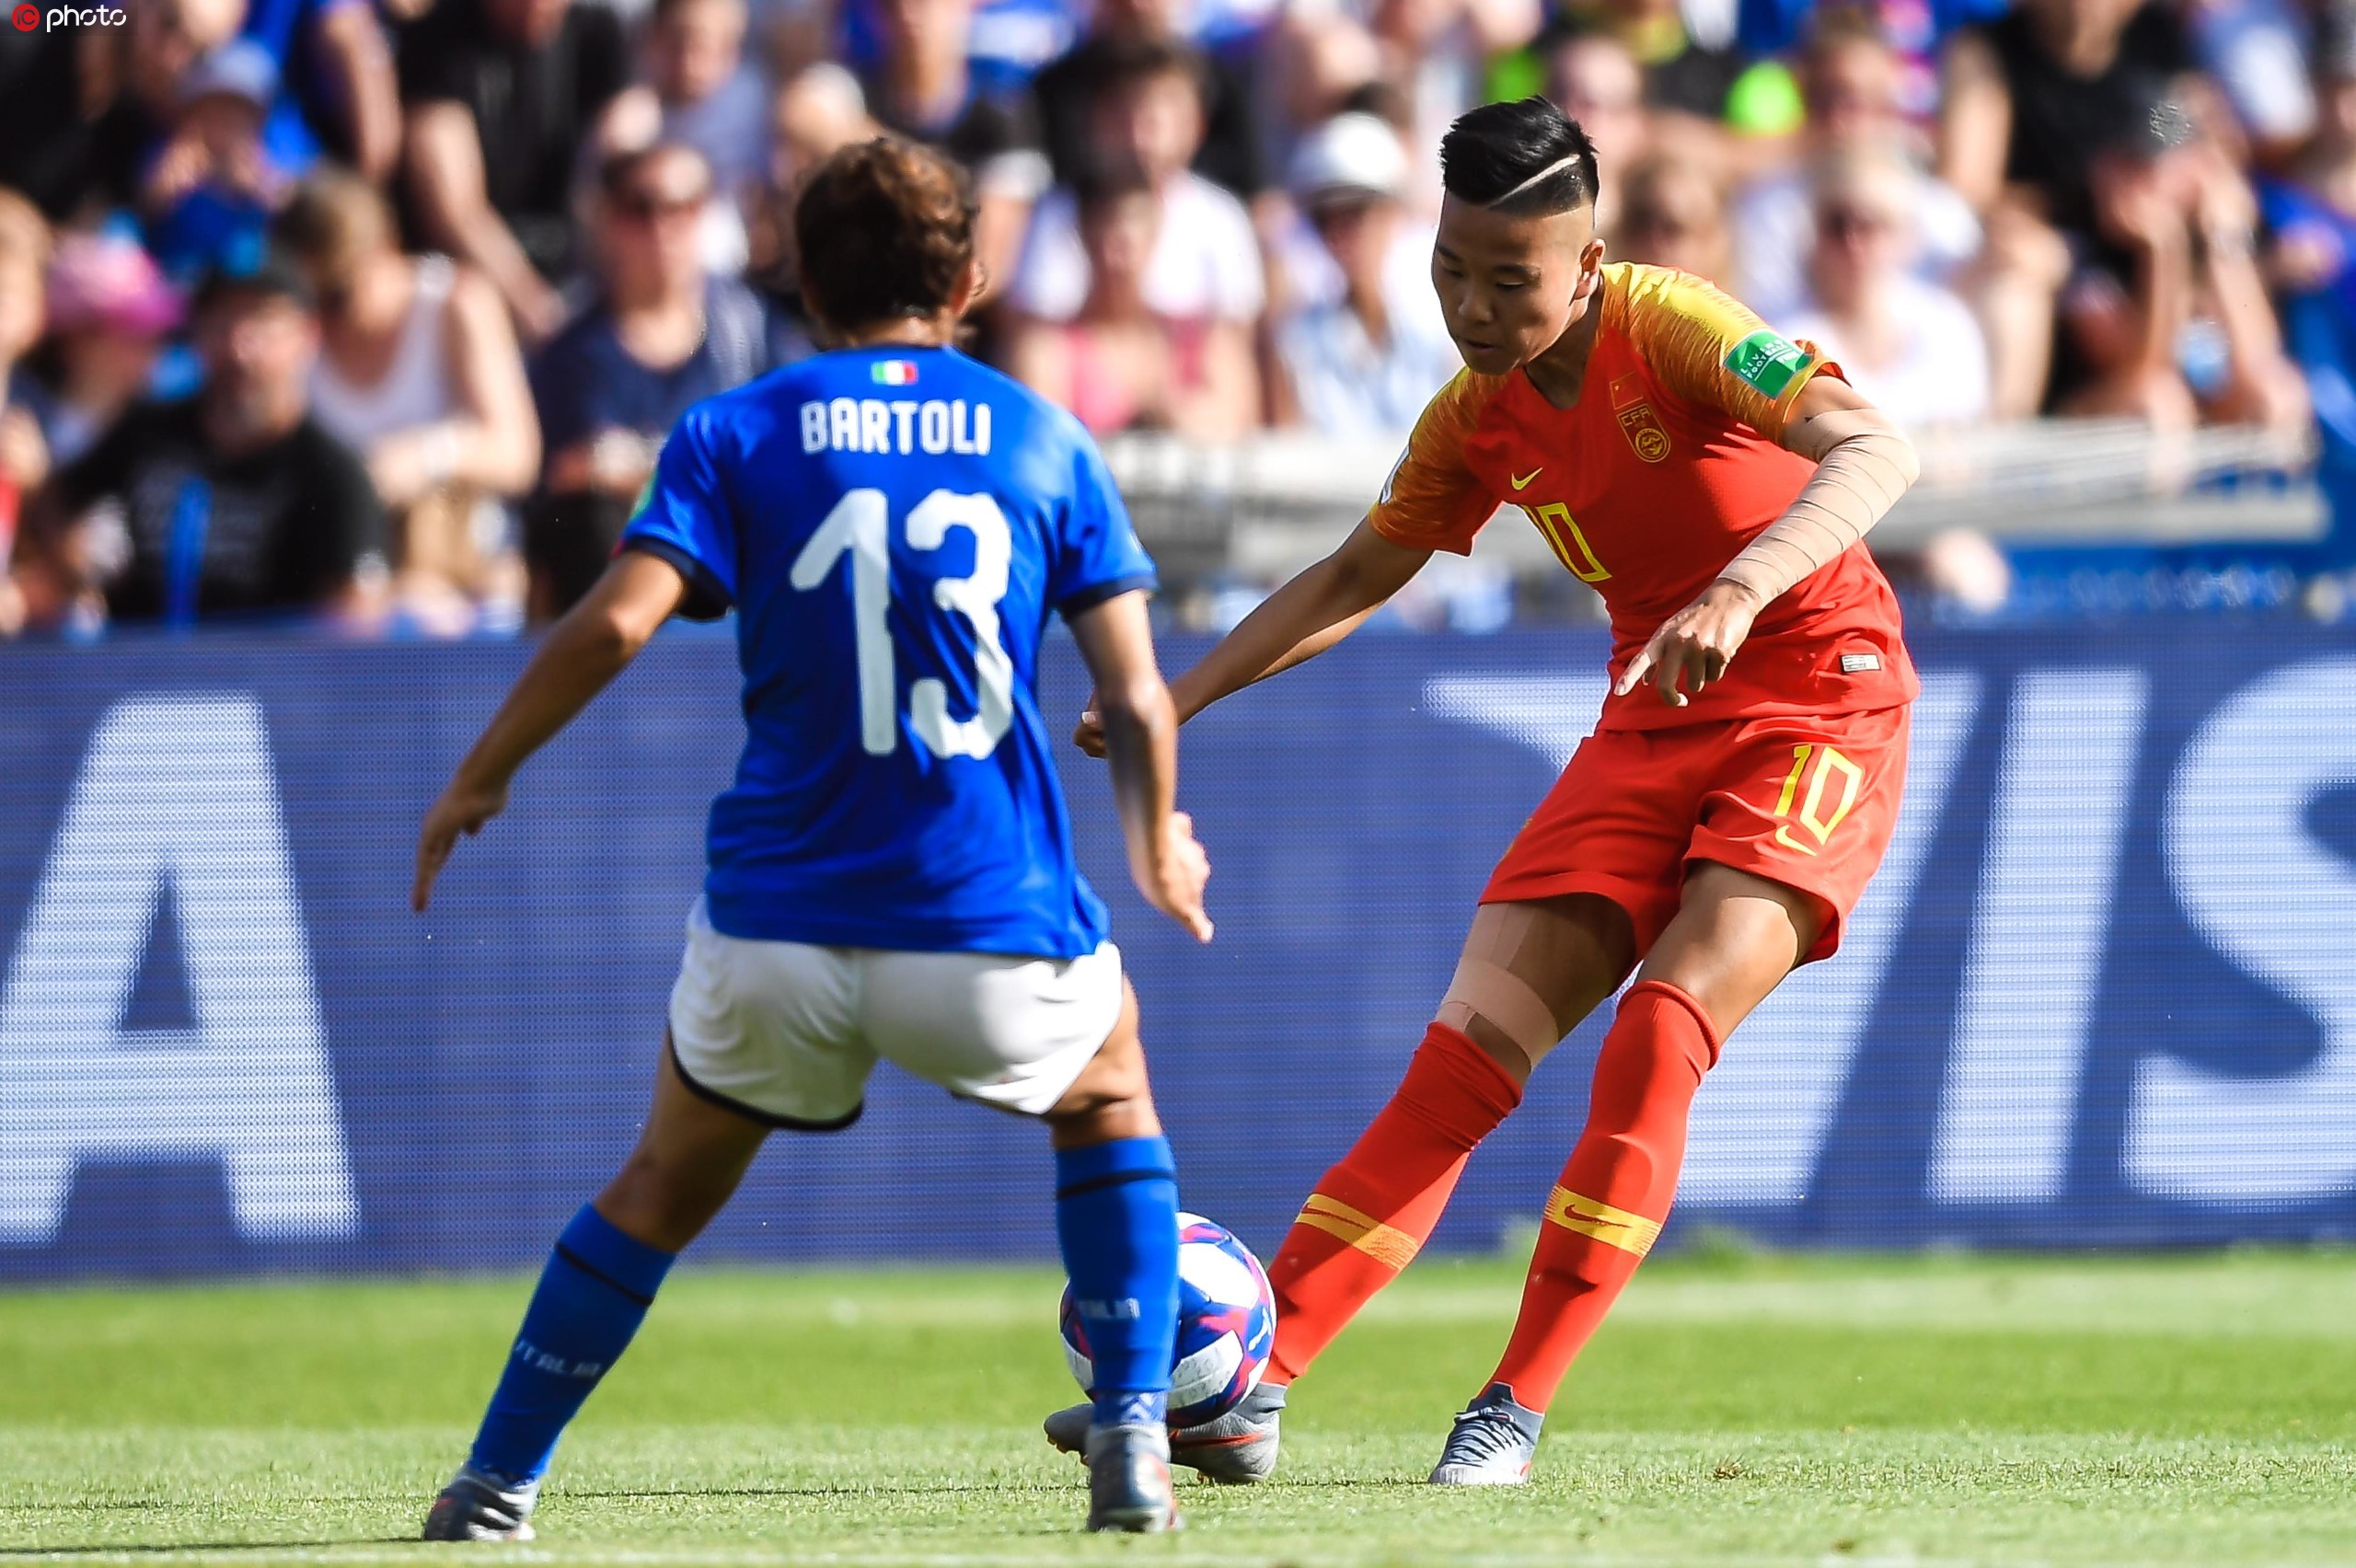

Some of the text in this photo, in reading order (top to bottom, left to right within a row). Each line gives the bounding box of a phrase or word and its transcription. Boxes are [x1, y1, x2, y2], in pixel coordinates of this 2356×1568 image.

[800, 398, 992, 455] BARTOLI
[1621, 408, 1651, 427] CFA
[790, 487, 1014, 761] 13
[1773, 744, 1864, 847] 10
